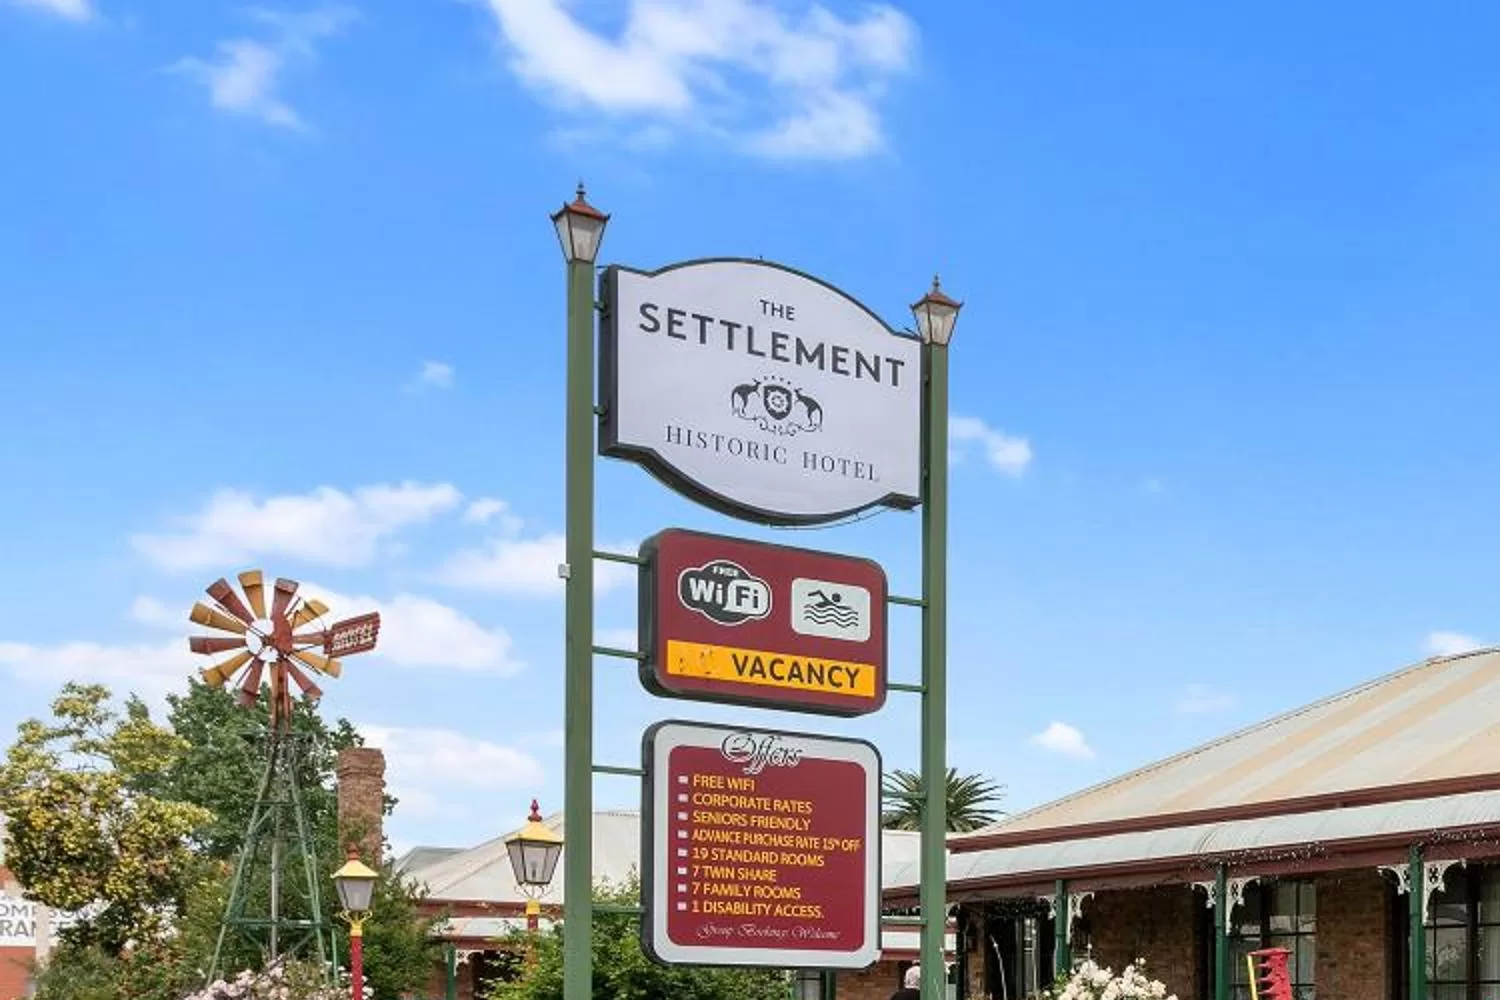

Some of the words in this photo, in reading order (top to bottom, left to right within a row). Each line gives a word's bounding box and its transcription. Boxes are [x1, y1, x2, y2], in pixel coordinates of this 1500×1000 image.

[760, 299, 796, 321] THE
[639, 302, 905, 387] SETTLEMENT
[666, 424, 788, 465] HISTORIC
[802, 450, 880, 482] HOTEL
[689, 577, 760, 609] WiFi
[732, 653, 861, 689] VACANCY
[722, 733, 803, 775] Offers
[693, 775, 724, 790] FREE
[727, 777, 755, 792] WIFI
[693, 792, 771, 811] CORPORATE
[774, 799, 813, 815] RATES
[693, 810, 748, 827] SENIORS
[751, 815, 811, 831] FRIENDLY
[692, 828, 744, 844] ADVANCE
[744, 832, 795, 848] PURCHASE
[795, 836, 820, 849] RATE
[841, 839, 861, 852] OFF
[692, 847, 708, 861] 19
[711, 848, 779, 864] STANDARD
[780, 853, 825, 867] ROOMS
[692, 865, 700, 878] 7
[702, 865, 735, 880] TWIN
[737, 867, 777, 882] SHARE
[692, 882, 700, 895] 7
[703, 882, 751, 897] FAMILY
[753, 885, 801, 899] ROOMS
[692, 901, 700, 913] 1
[703, 901, 772, 916] DISABILITY
[773, 904, 825, 919] ACCESS.
